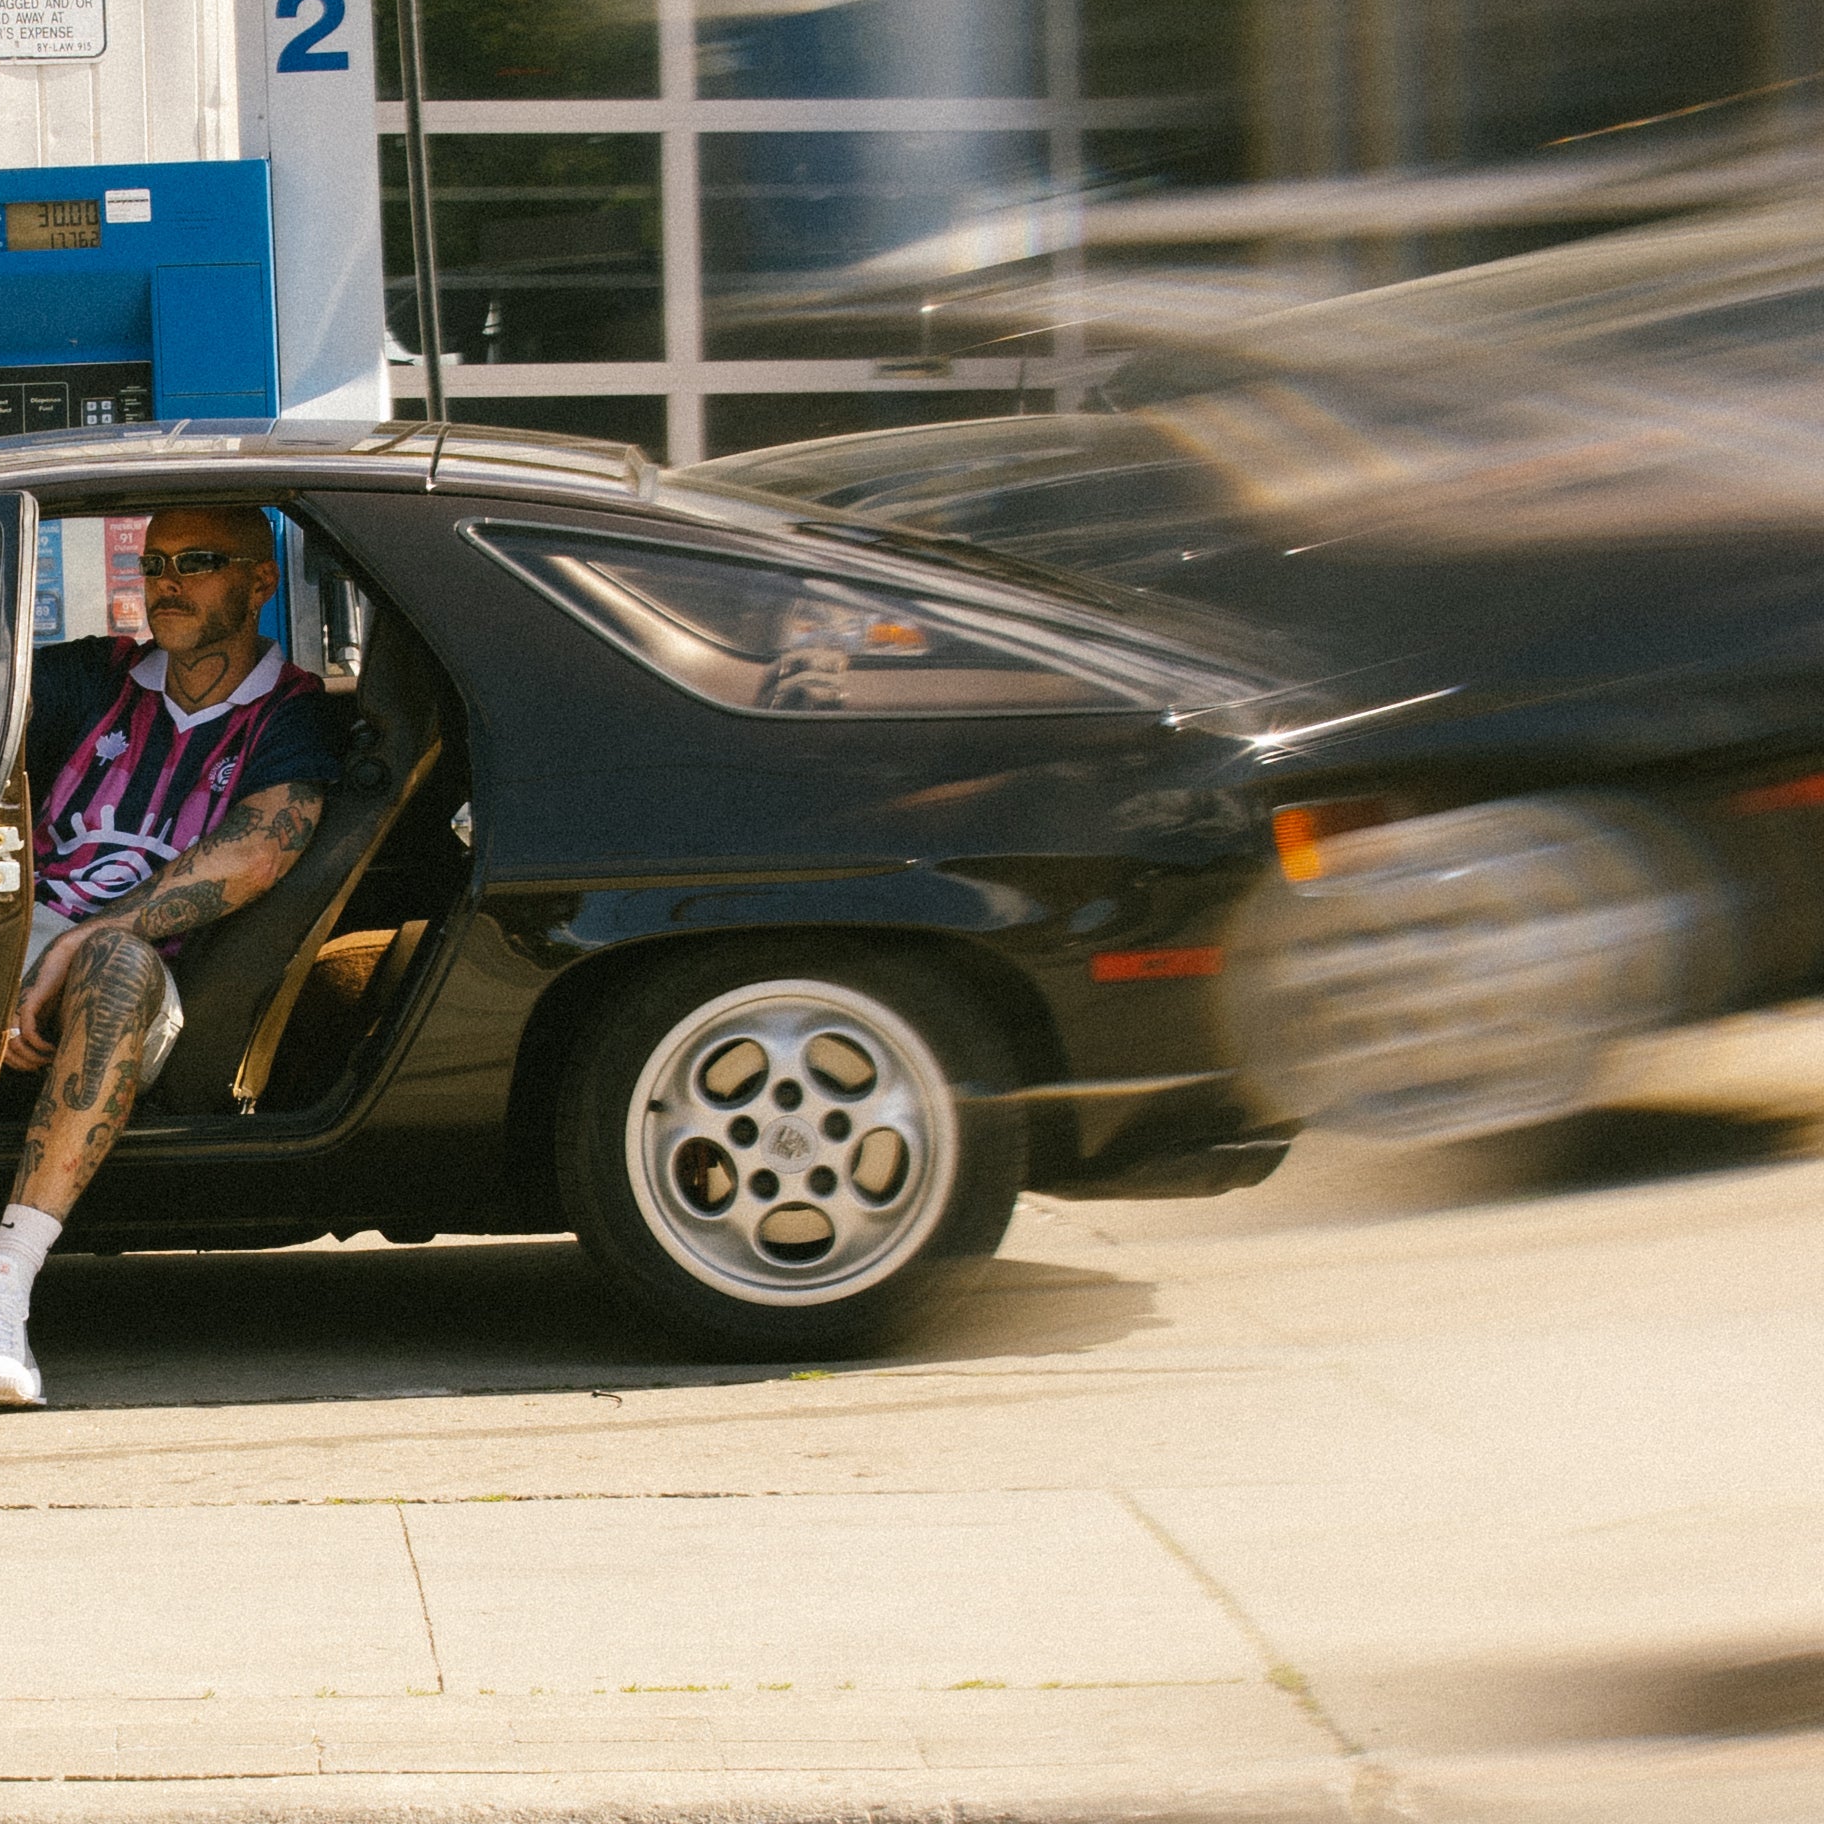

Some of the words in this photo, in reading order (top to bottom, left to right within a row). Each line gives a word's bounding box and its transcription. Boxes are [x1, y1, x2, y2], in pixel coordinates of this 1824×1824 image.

[16, 12, 45, 24] AWAY
[51, 11, 64, 24] AT
[20, 26, 74, 39] EXPENSE
[37, 43, 74, 53] BY-LAW
[77, 42, 92, 52] 915
[38, 201, 99, 227] 30.00
[120, 533, 133, 544] 91
